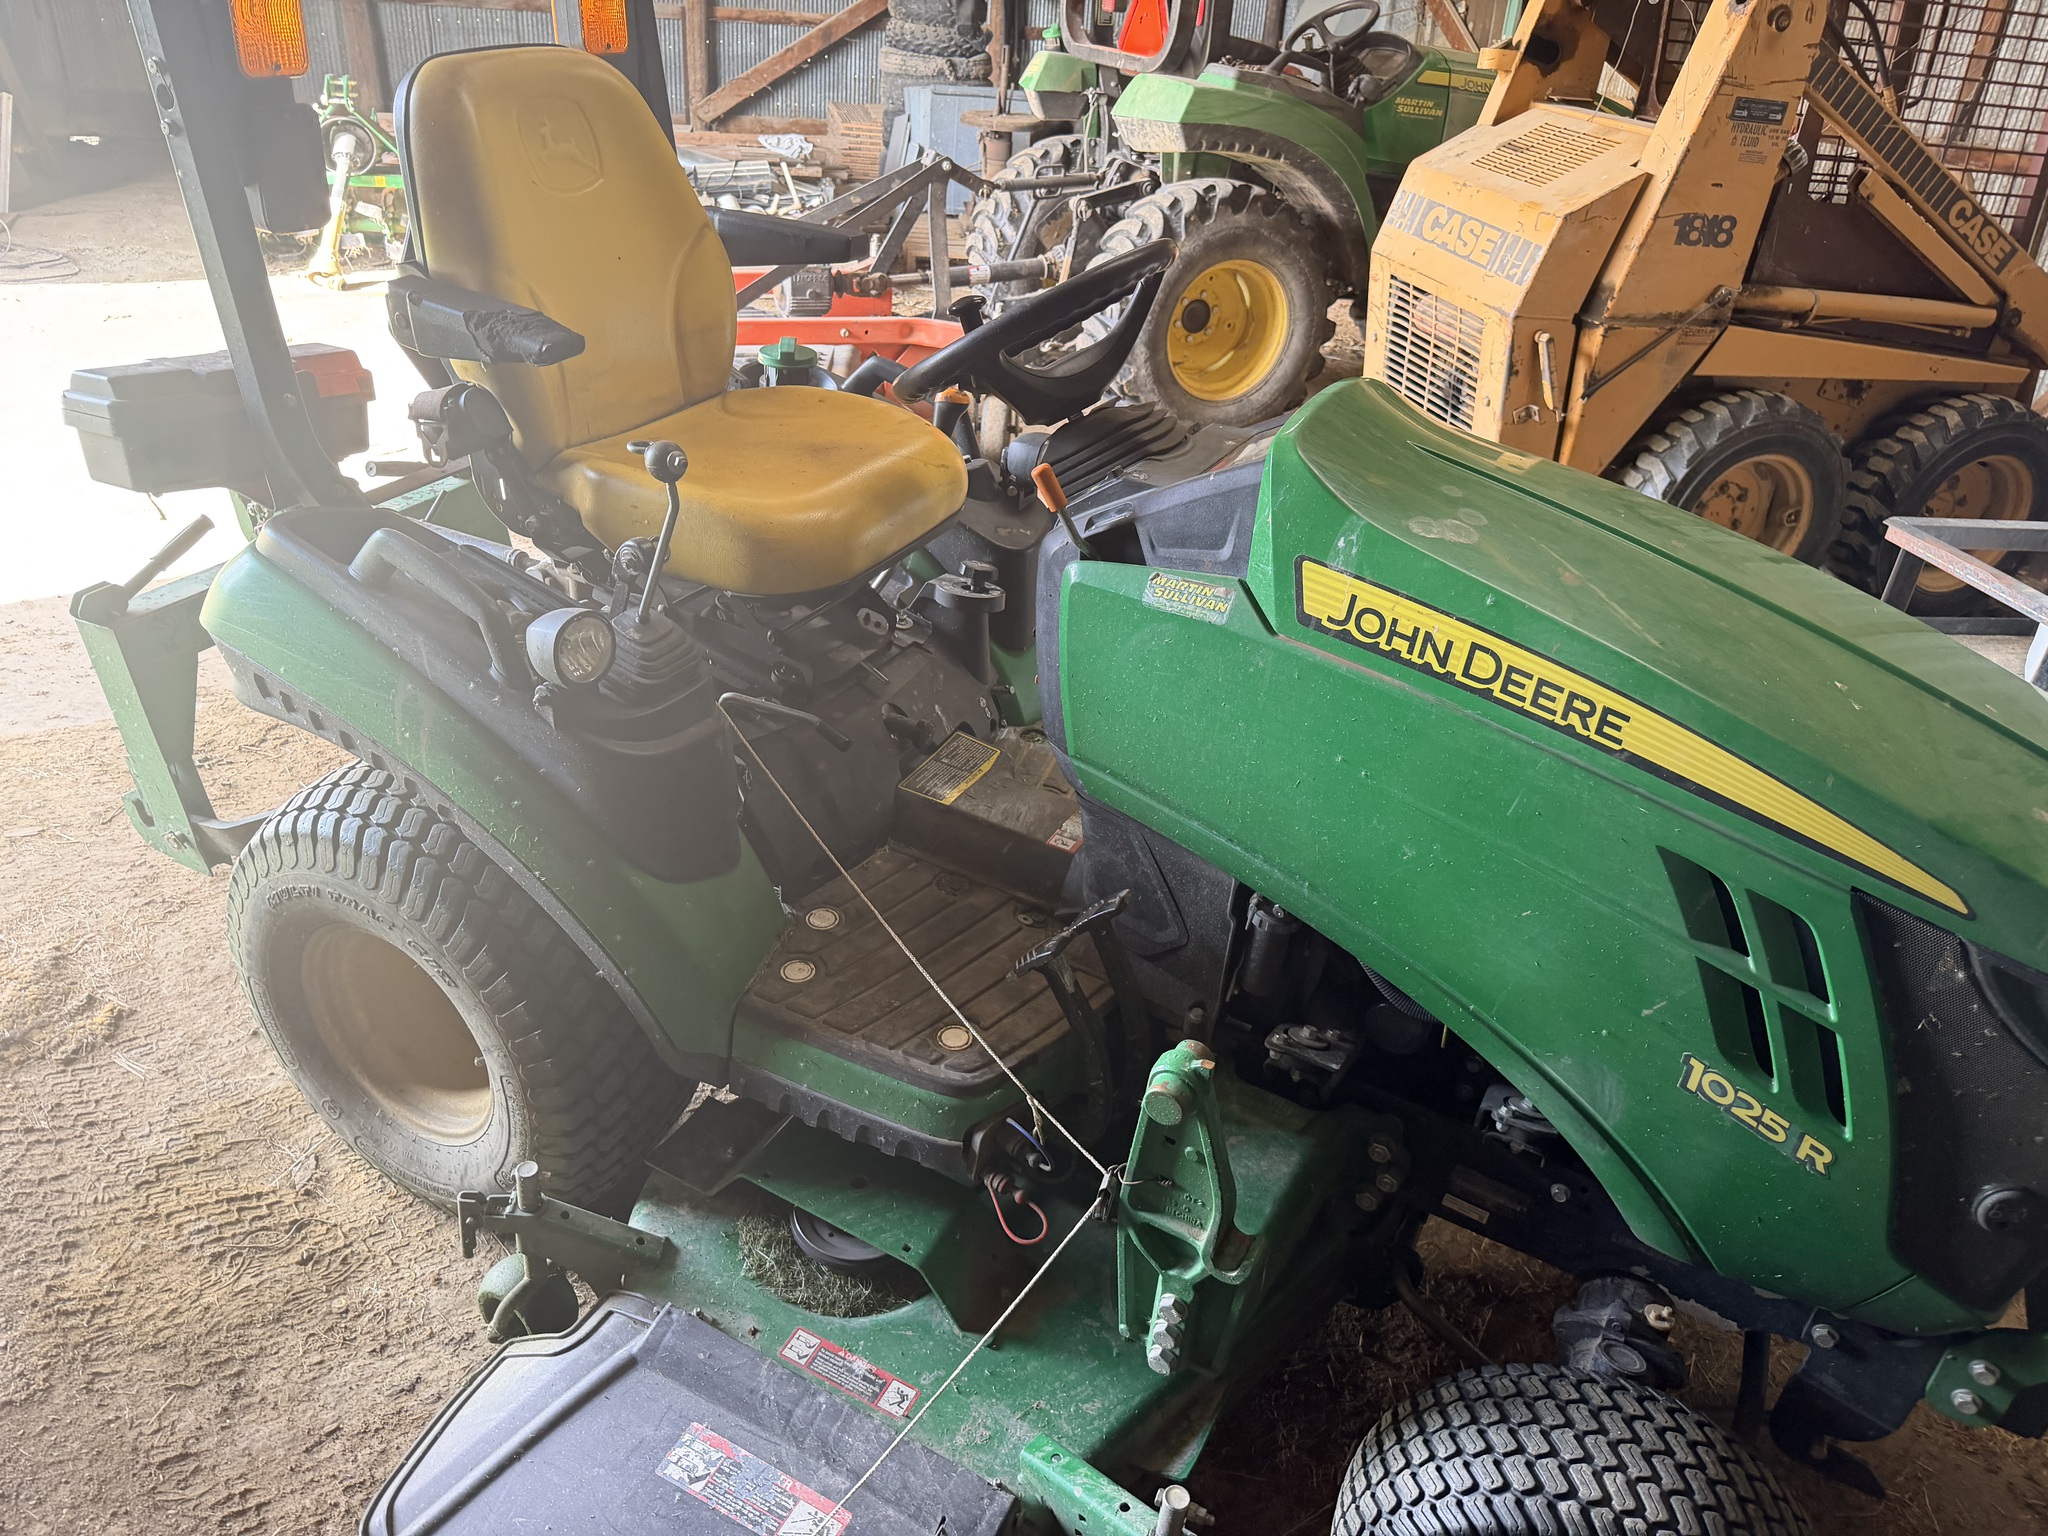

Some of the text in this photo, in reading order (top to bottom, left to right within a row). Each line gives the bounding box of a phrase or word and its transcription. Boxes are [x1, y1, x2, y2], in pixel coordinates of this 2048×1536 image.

[1460, 77, 1495, 93] JOHN
[1395, 97, 1435, 108] MARTIN
[1396, 104, 1443, 117] SULLIVAN
[1731, 122, 1768, 136] HYDRAULIC
[1740, 136, 1760, 148] FLUID
[1422, 206, 1499, 266] CASE
[1673, 213, 1738, 248] 1818
[1948, 199, 2012, 269] CASE
[1152, 576, 1216, 597] MARTIN
[1152, 587, 1229, 613] SULLIVAN
[1326, 593, 1632, 747] JOHN DEERE
[266, 884, 321, 909] MULTI
[1685, 1056, 1834, 1175] 1025 R
[845, 1352, 877, 1374] DANGER
